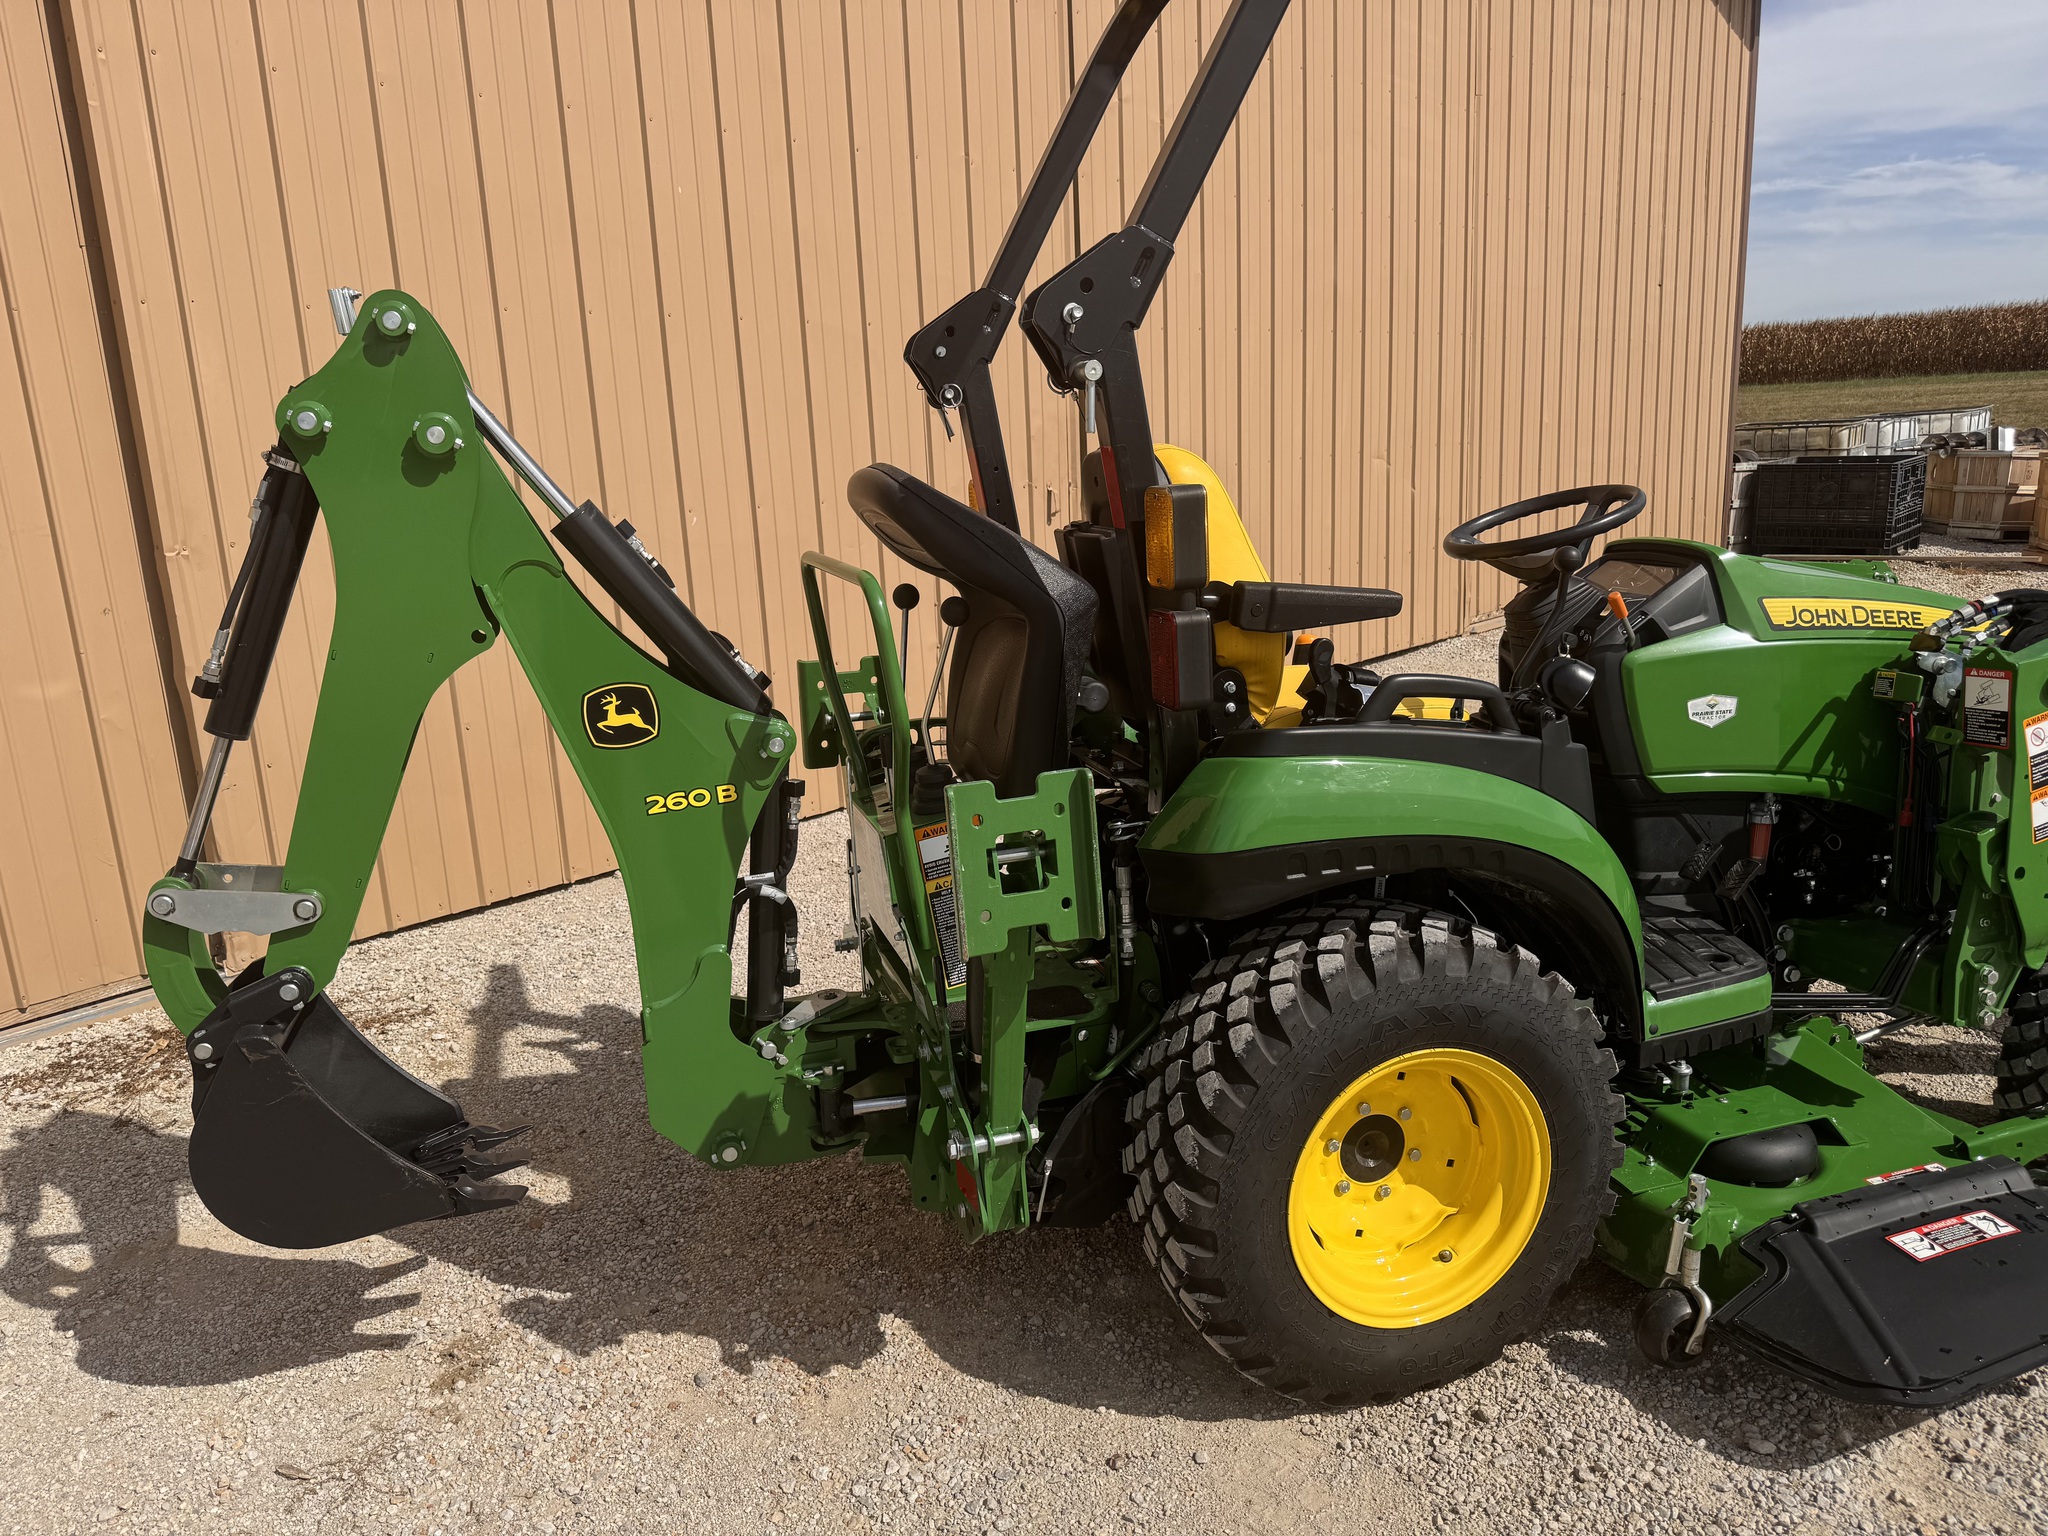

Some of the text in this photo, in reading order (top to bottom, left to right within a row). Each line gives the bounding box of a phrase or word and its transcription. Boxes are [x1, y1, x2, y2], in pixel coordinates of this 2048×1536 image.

[1784, 604, 1924, 626] JOHN DEERE
[1979, 670, 2005, 678] DANGER
[645, 784, 738, 815] 260 B
[1262, 1002, 1498, 1151] GALAXY
[1929, 1218, 1960, 1231] DANGER
